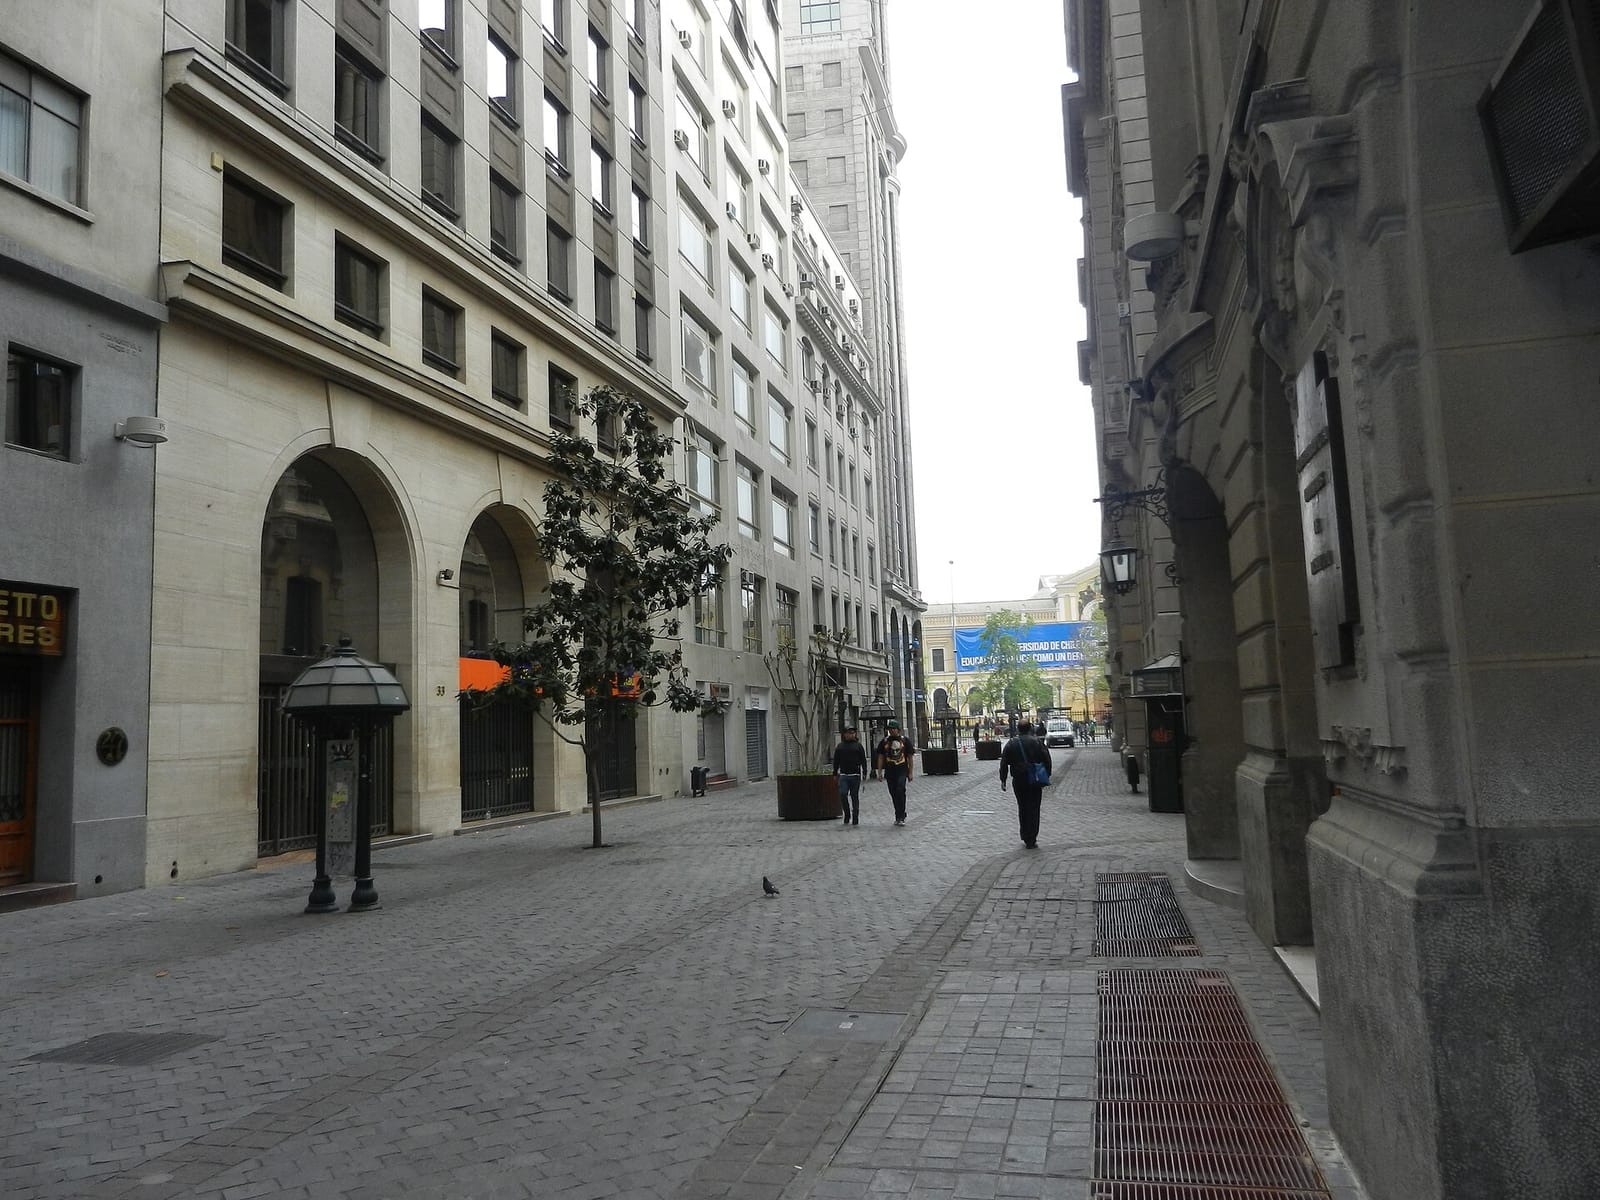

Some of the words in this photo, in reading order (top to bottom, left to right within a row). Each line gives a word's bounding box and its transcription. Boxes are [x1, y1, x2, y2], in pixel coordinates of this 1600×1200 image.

[1050, 641, 1060, 650] DE
[1033, 652, 1053, 663] COMO
[1055, 652, 1066, 662] UN
[436, 685, 445, 697] 33
